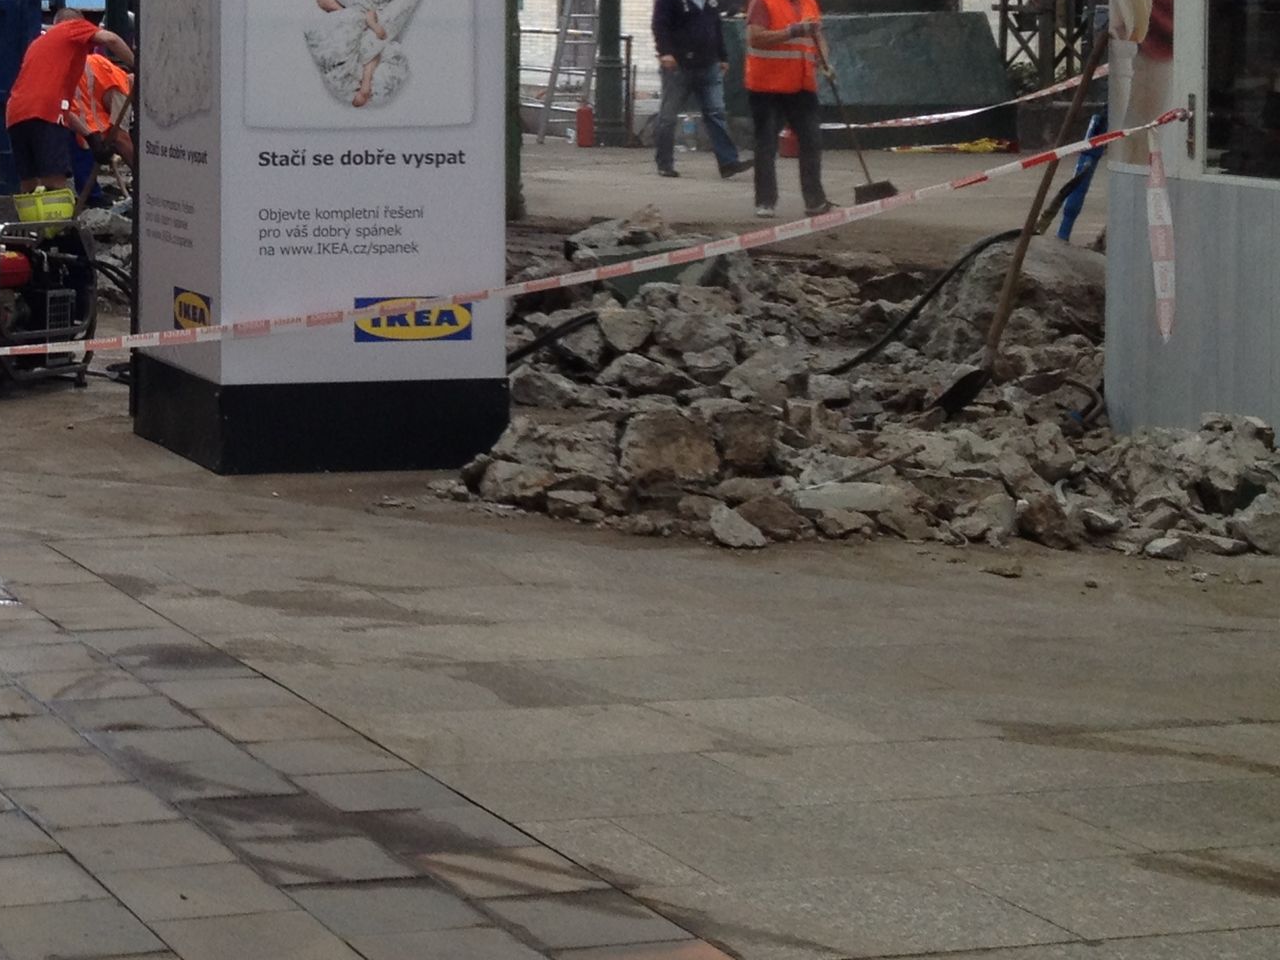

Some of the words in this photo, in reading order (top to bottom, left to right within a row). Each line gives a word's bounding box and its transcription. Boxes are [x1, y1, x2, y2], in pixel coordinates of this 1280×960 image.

[258, 149, 306, 167] Stačí
[312, 153, 334, 166] se
[340, 149, 396, 166] dobře
[402, 150, 466, 169] vyspat
[258, 208, 311, 223] Objevte
[315, 206, 380, 222] kompletní
[258, 228, 281, 240] pro
[285, 224, 309, 238] váš
[355, 223, 403, 239] spánek
[258, 246, 275, 256] na
[178, 300, 207, 326] IKEA
[371, 309, 460, 328] IKEA
